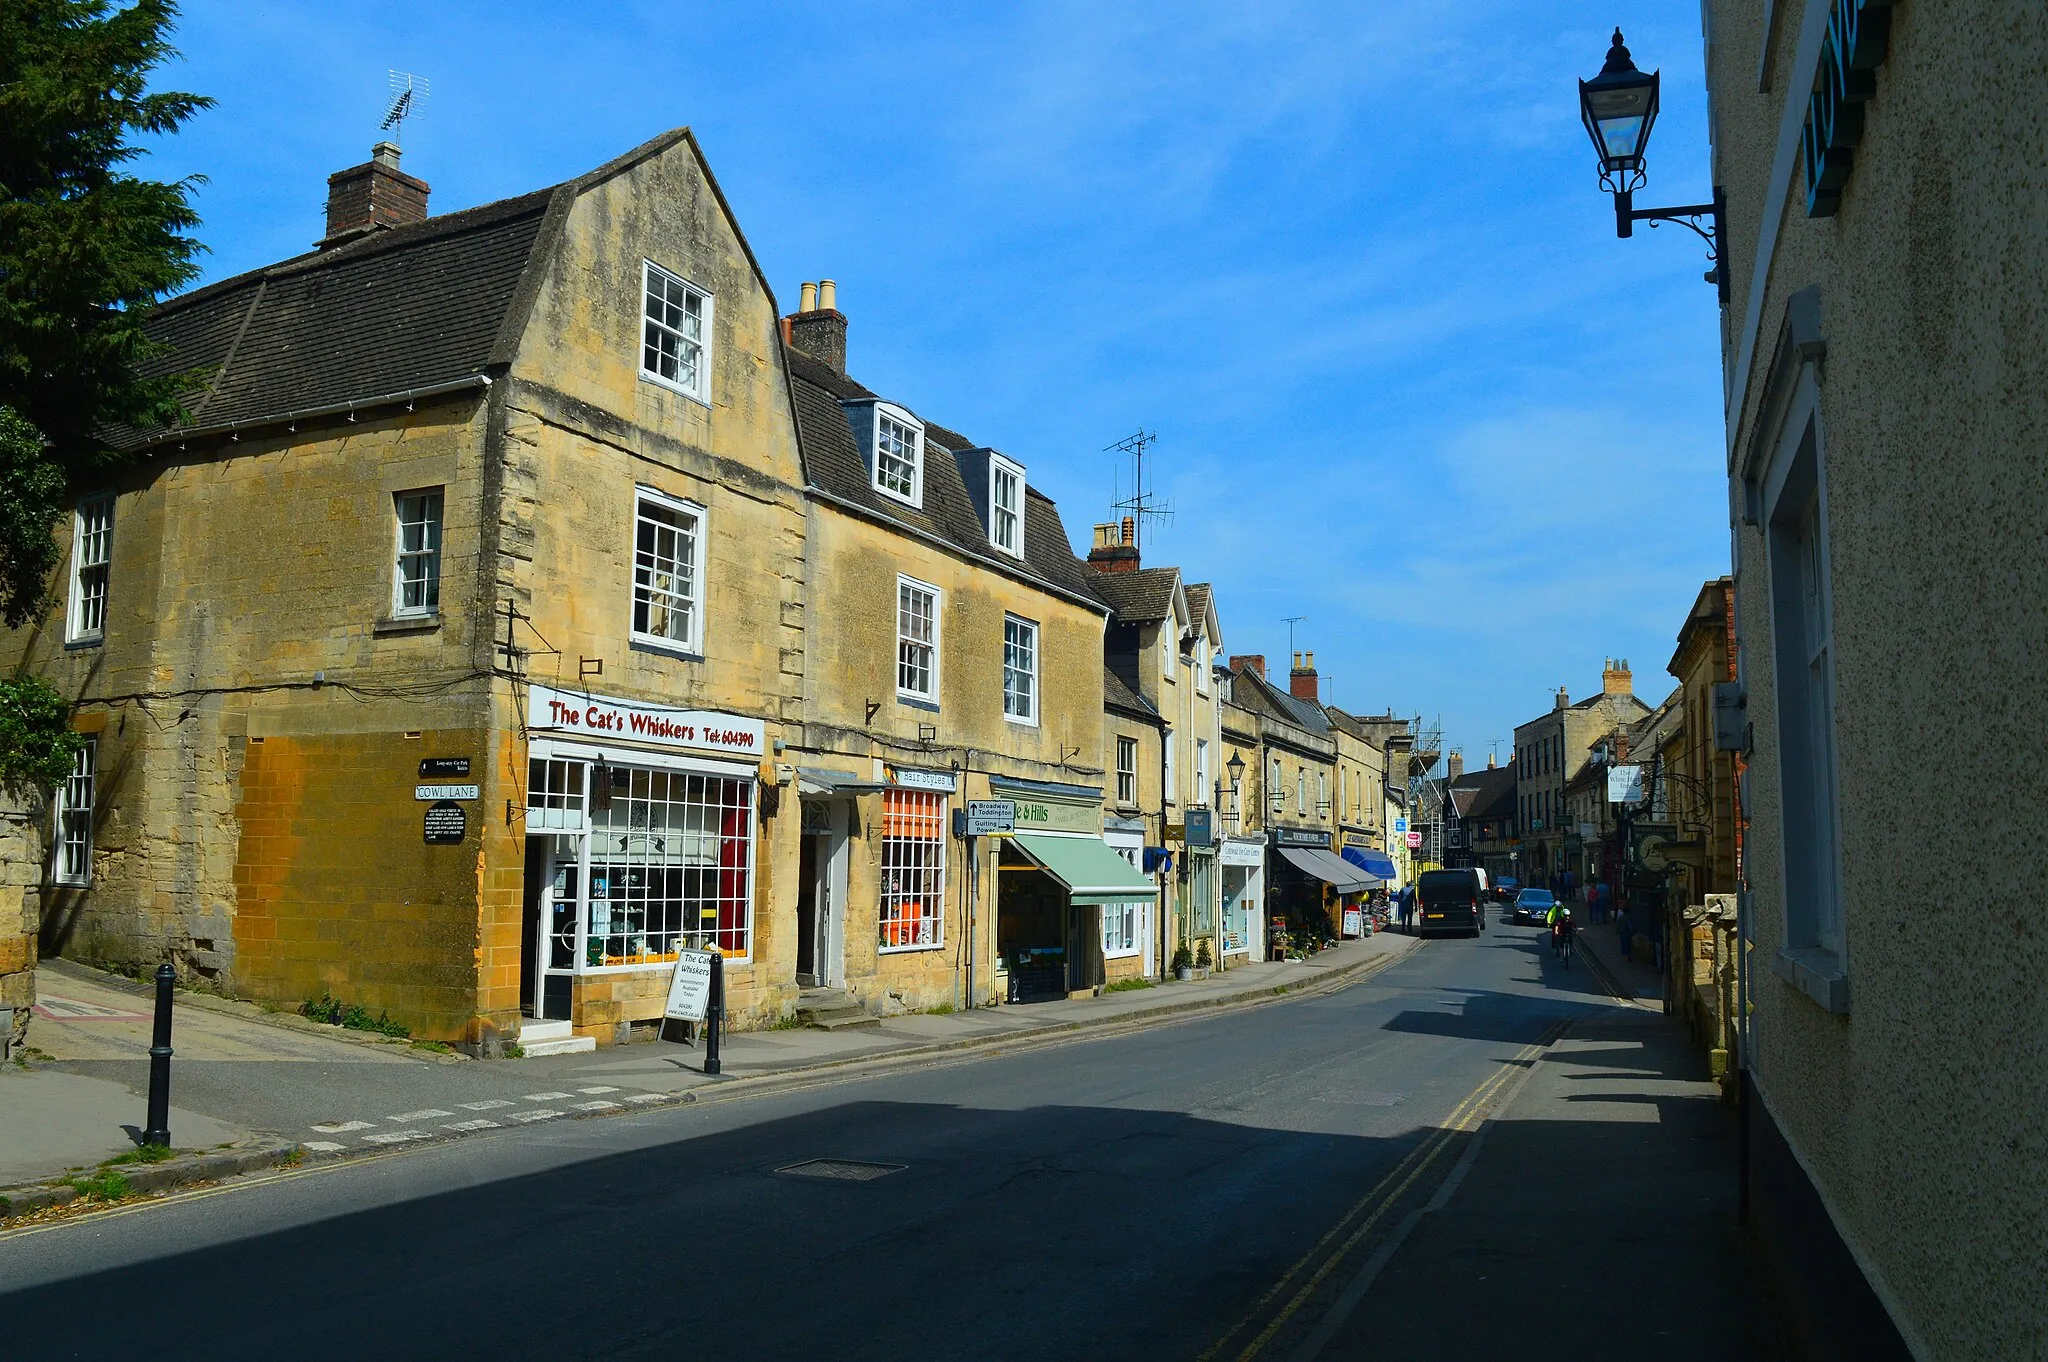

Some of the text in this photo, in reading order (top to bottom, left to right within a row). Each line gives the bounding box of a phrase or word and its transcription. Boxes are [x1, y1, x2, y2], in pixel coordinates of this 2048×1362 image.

[549, 700, 580, 727] The
[585, 706, 624, 732] Cat's
[629, 712, 695, 741] Whiskers
[721, 728, 754, 748] 604390
[904, 772, 919, 782] Hair
[922, 774, 946, 787] Styles
[419, 787, 475, 798] COWL LANE
[1023, 804, 1030, 820] &
[1030, 804, 1049, 822] Hills
[975, 821, 997, 829] Guiting
[684, 954, 697, 963] The
[681, 965, 710, 976] Whiskers
